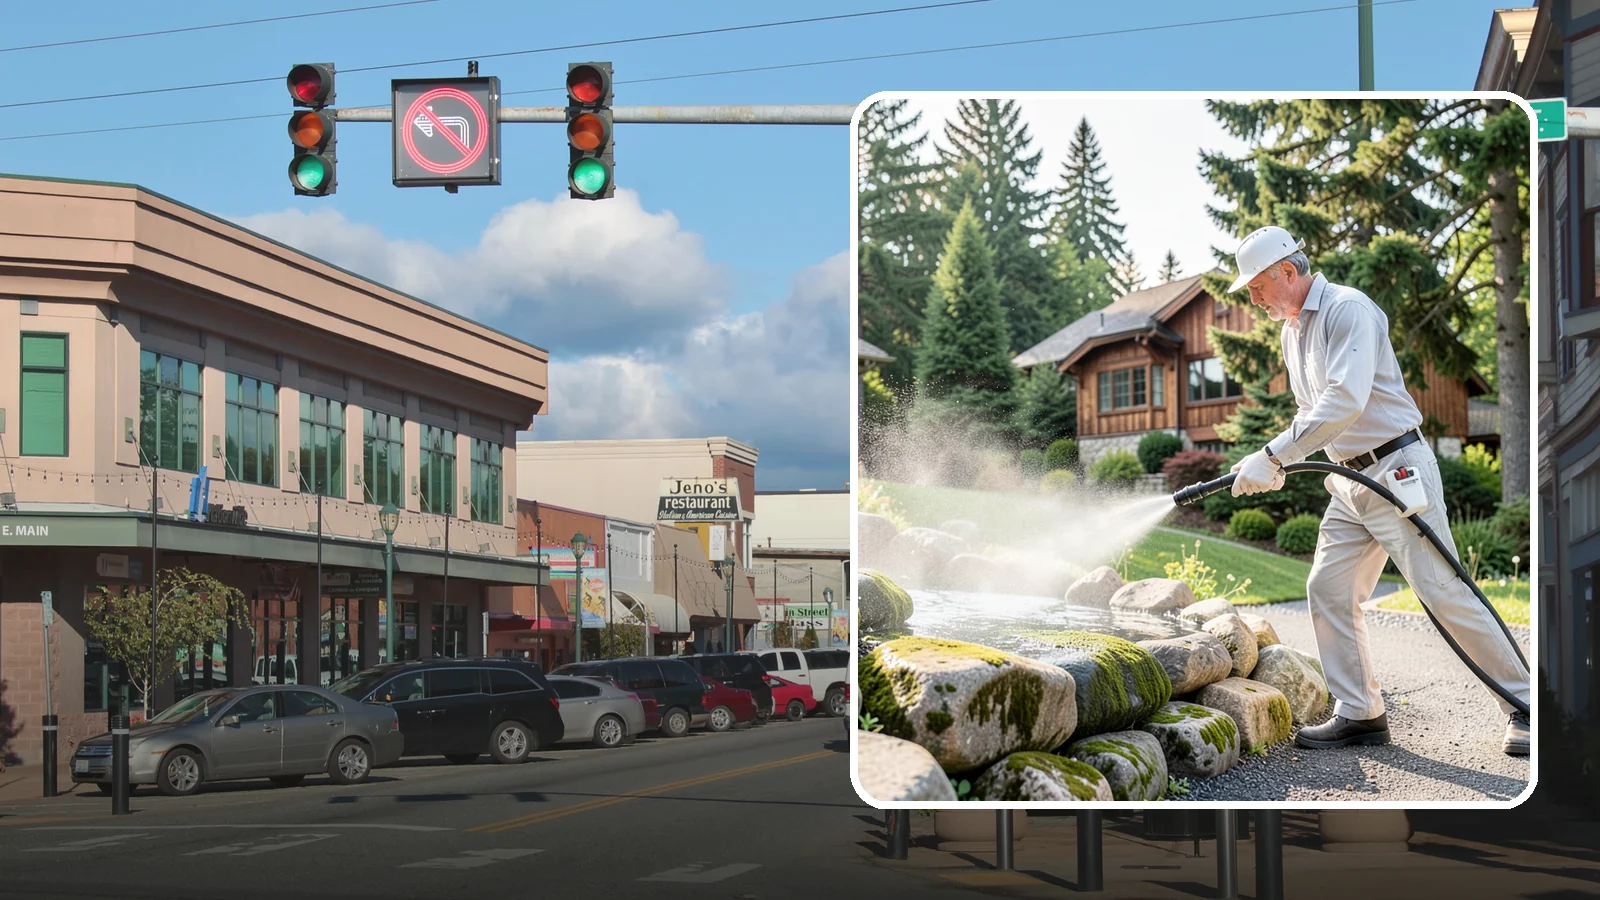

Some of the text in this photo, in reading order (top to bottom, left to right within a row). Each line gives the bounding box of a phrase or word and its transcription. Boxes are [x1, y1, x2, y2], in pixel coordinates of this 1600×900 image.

[670, 480, 727, 494] Jeno's
[665, 496, 731, 509] restaurant
[659, 510, 681, 519] Italian
[686, 510, 714, 519] American
[715, 509, 737, 519] Cuisine
[2, 525, 49, 536] E. MAIN
[797, 607, 828, 617] Street
[791, 619, 824, 627] lass
